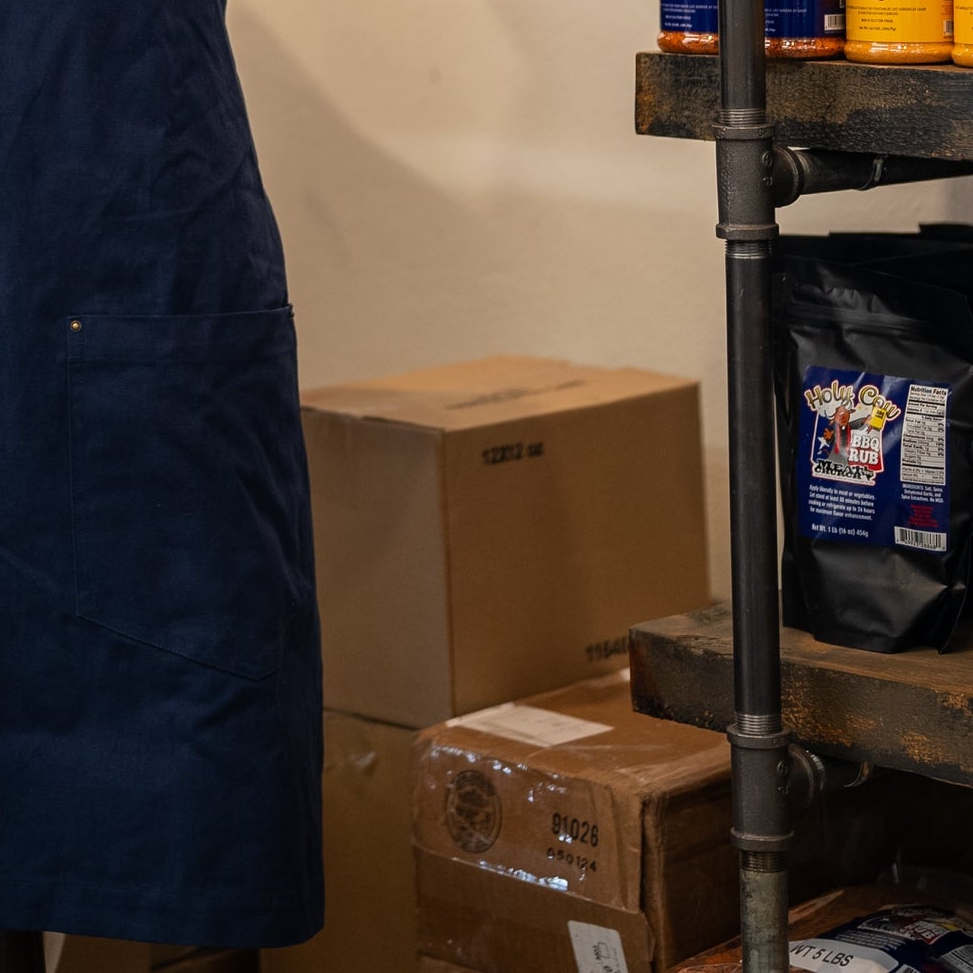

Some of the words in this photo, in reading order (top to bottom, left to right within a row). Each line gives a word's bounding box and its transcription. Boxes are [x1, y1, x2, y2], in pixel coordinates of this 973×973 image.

[805, 381, 852, 409] Holy
[859, 386, 900, 420] Cow
[851, 434, 880, 451] BBQ
[848, 448, 879, 465] RUB
[813, 948, 822, 958] 5
[822, 952, 854, 967] LBS
